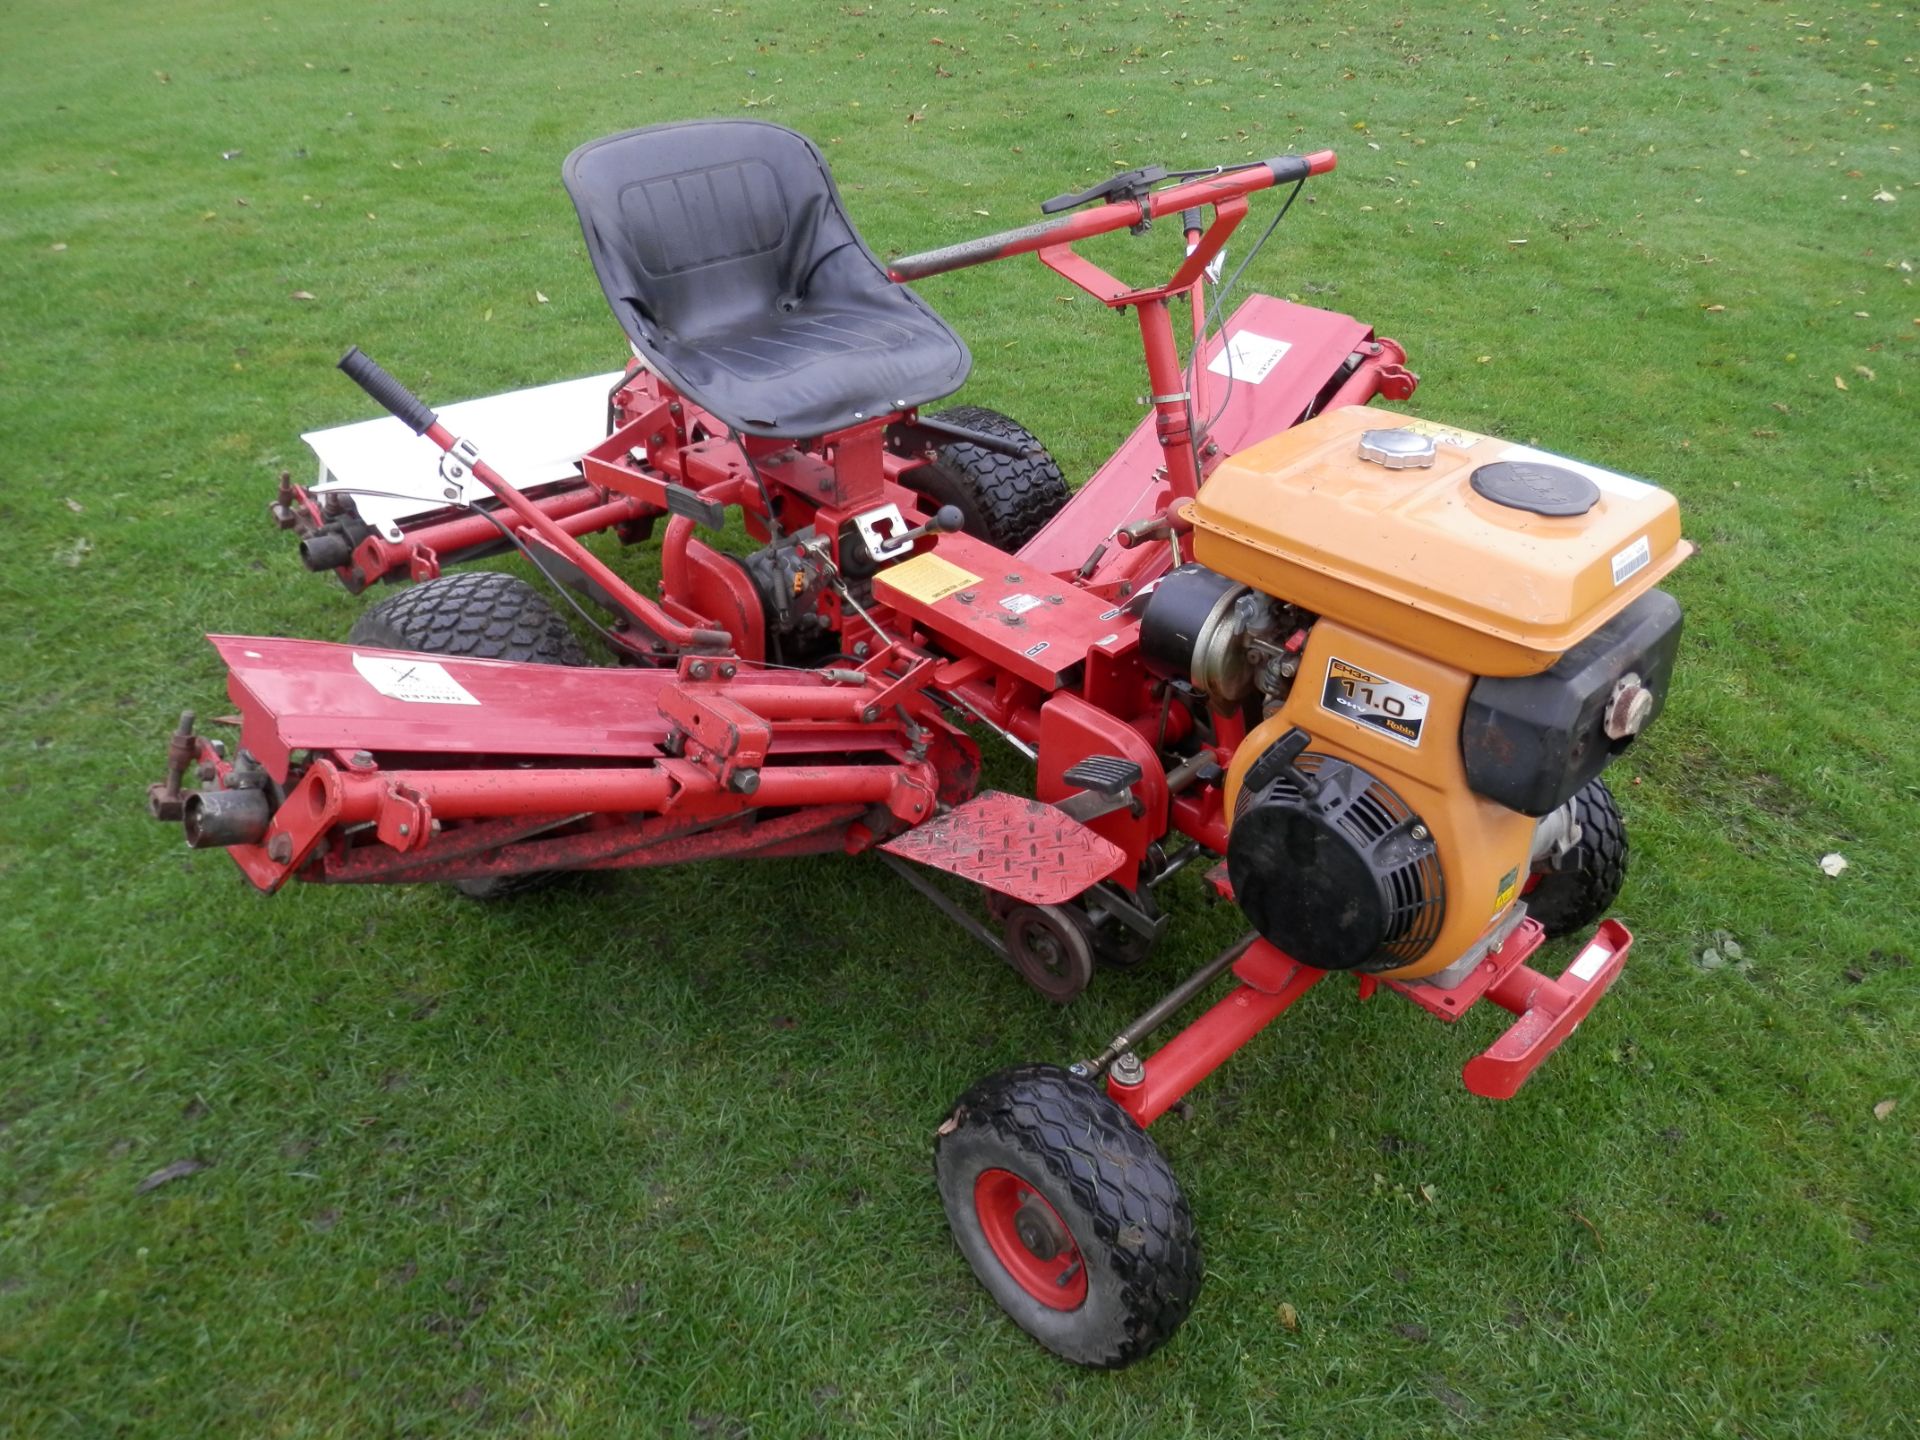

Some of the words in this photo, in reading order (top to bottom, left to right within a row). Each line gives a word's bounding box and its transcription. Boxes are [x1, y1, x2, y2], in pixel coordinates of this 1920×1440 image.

[873, 546, 881, 554] 2
[1334, 662, 1371, 682] EH34
[1336, 697, 1367, 713] OHV
[1342, 680, 1405, 717] 11.0
[1385, 719, 1416, 738] Robin
